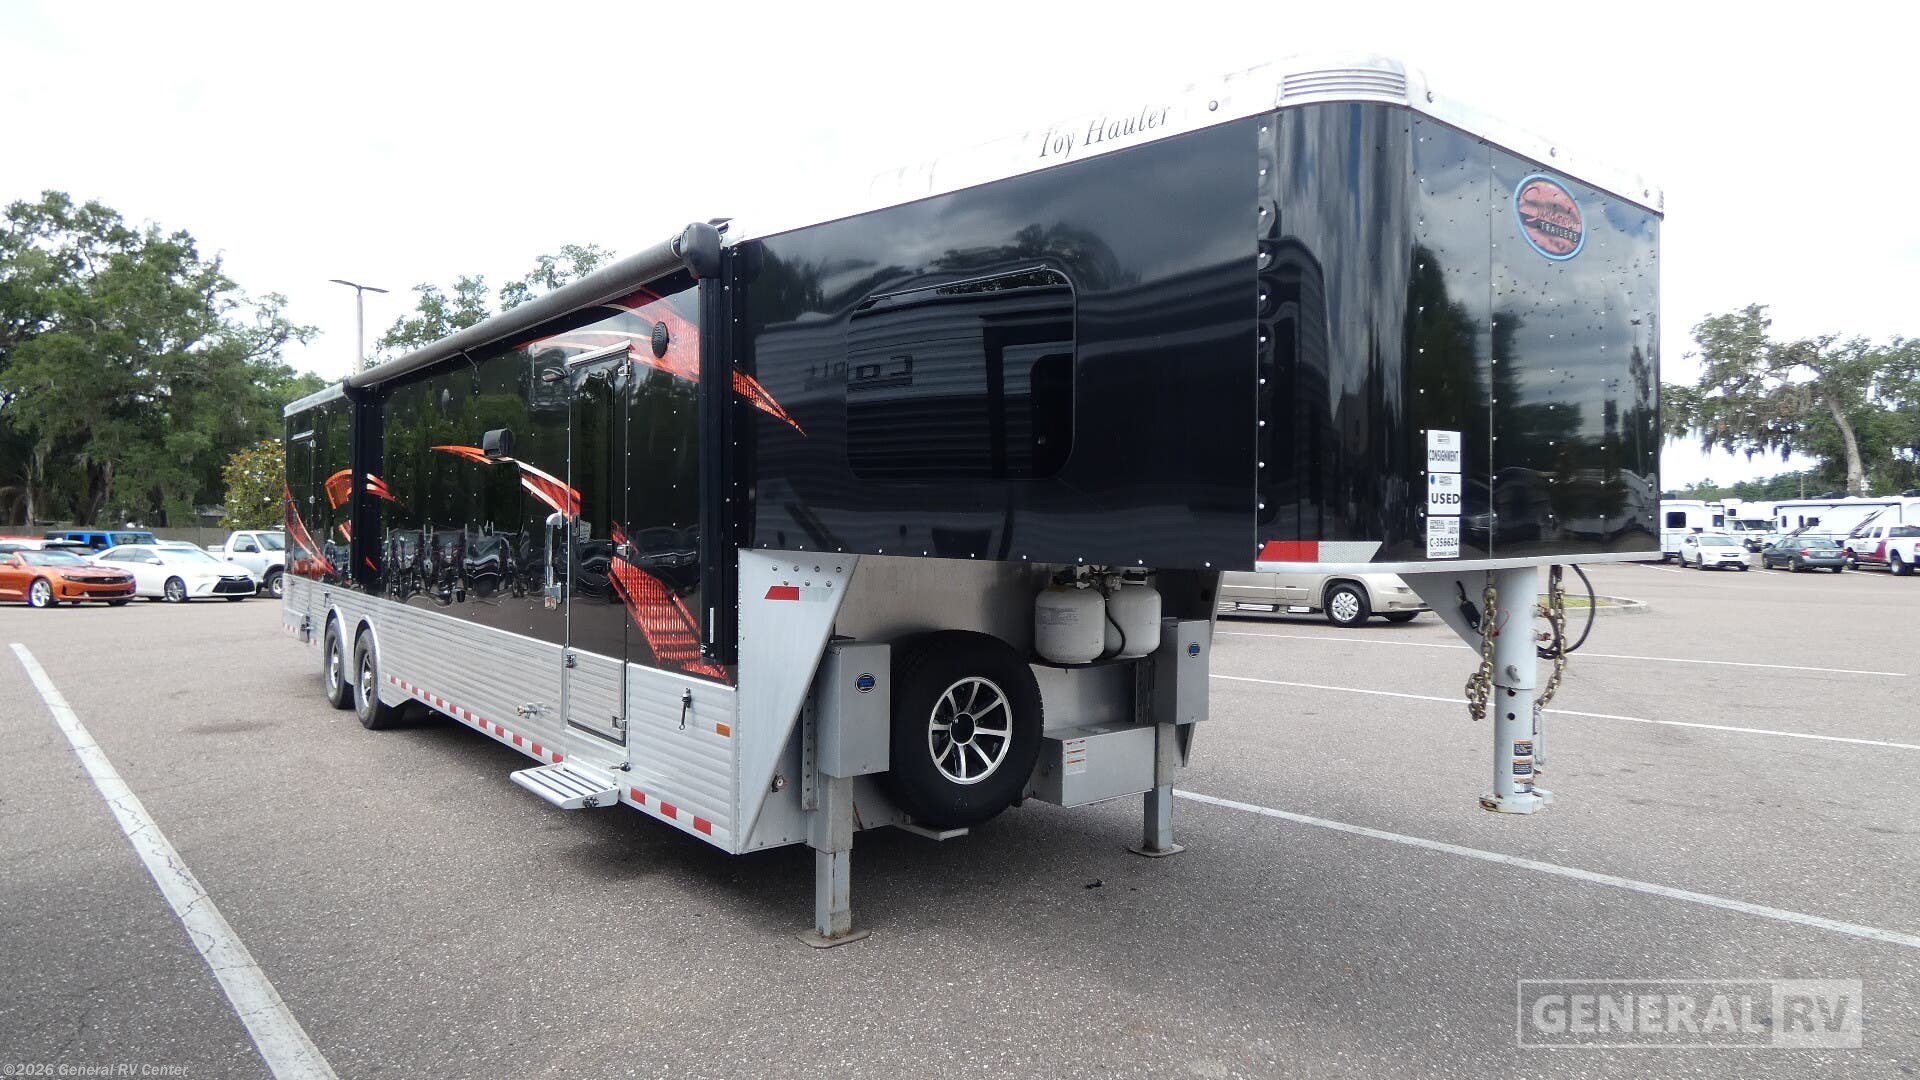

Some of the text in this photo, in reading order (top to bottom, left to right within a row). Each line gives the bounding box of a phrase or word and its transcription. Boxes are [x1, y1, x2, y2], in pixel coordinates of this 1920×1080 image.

[1039, 103, 1171, 159] Toy Hauler
[1540, 221, 1578, 242] TRAILERS
[1431, 493, 1460, 504] USED
